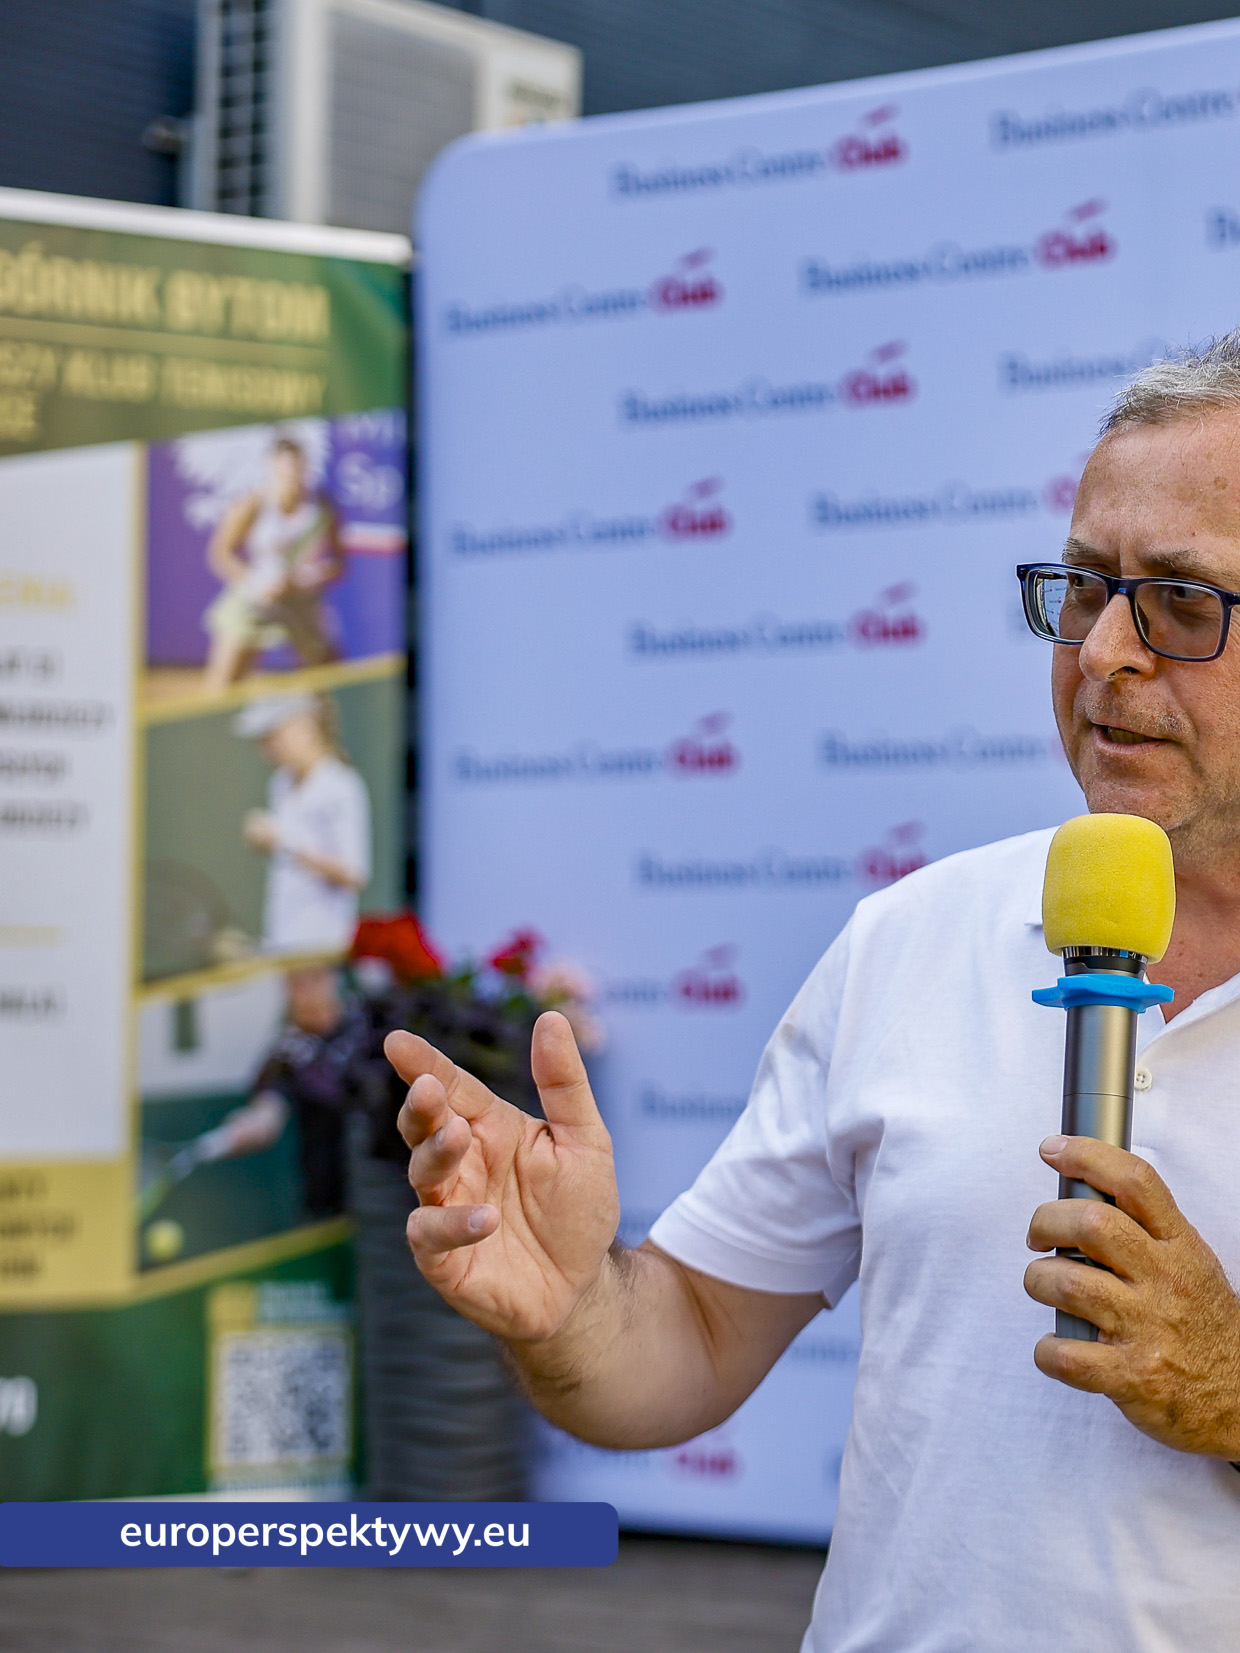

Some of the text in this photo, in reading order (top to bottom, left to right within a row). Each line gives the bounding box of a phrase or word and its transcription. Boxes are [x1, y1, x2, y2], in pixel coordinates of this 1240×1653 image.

[991, 105, 1126, 152] Business
[1127, 83, 1240, 131] Centre
[833, 132, 909, 176] Club
[1035, 224, 1118, 271] Club
[651, 273, 725, 315] Club
[842, 367, 919, 413] Club
